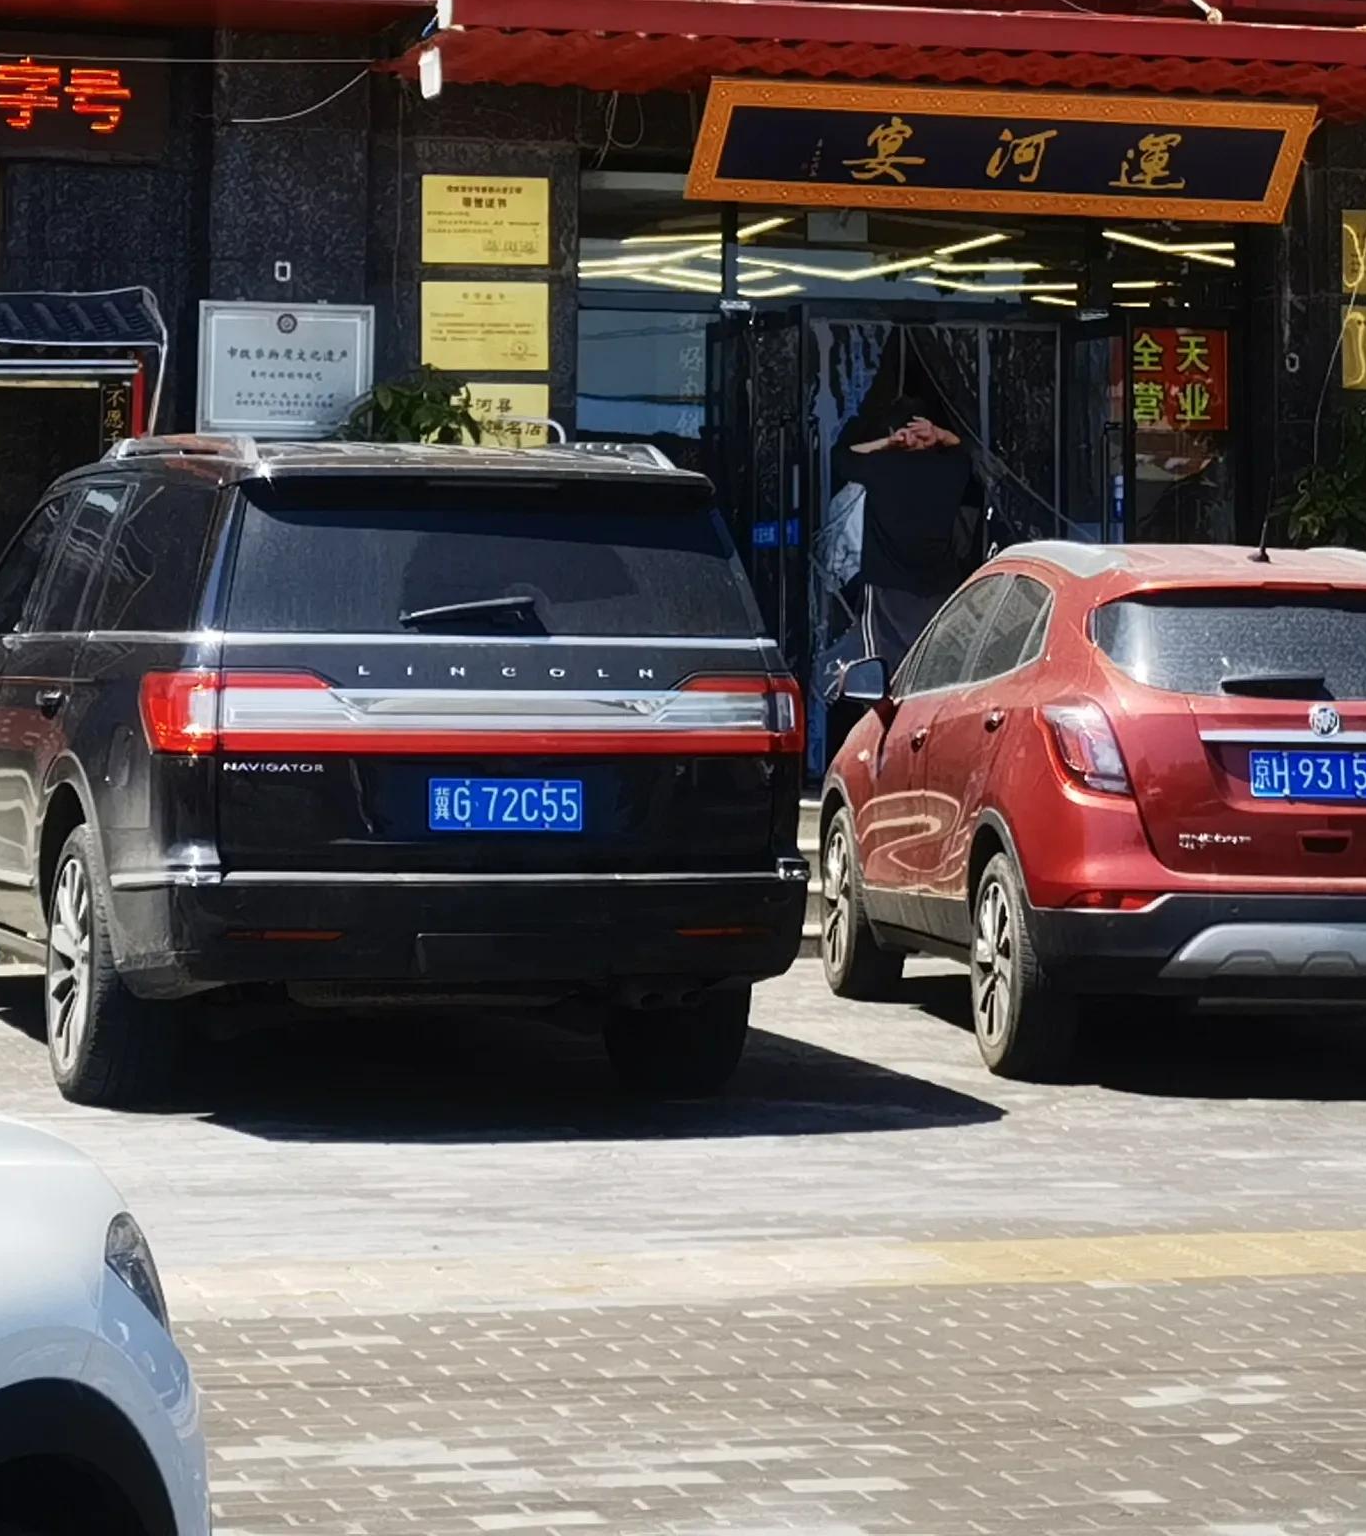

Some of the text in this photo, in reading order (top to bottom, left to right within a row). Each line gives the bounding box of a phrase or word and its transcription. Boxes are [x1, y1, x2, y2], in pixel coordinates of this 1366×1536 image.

[1132, 332, 1211, 373] 全天
[1133, 381, 1212, 425] 营业
[356, 664, 655, 681] LINCOLN
[222, 761, 325, 774] NAVIGATOR
